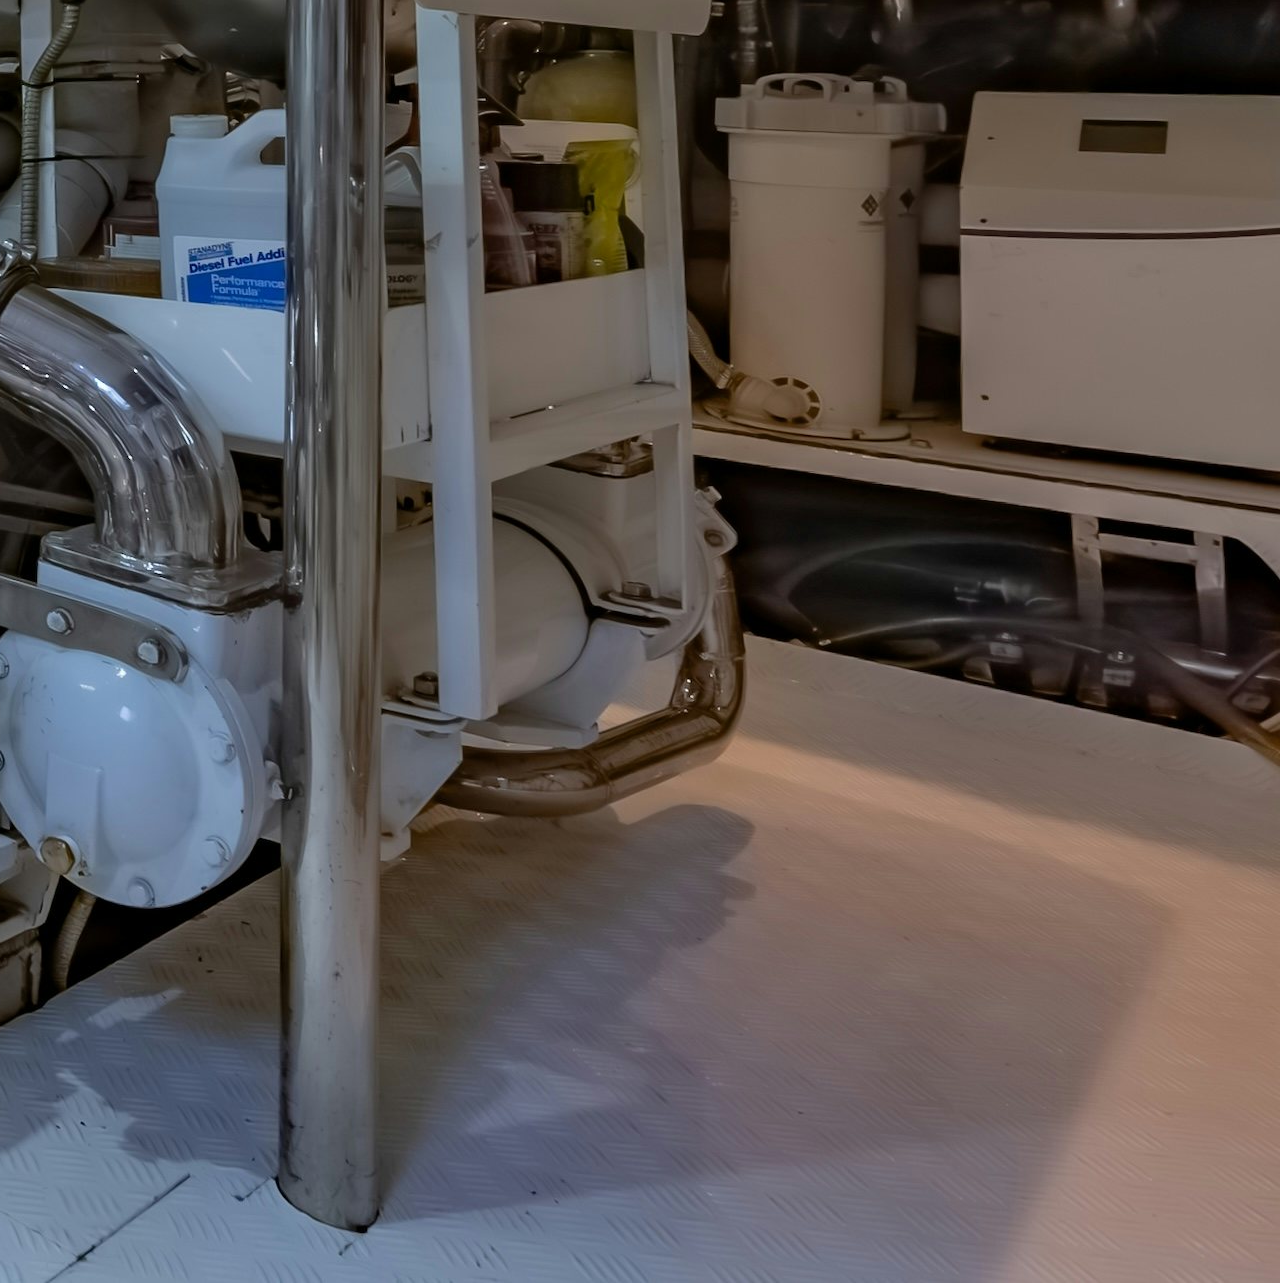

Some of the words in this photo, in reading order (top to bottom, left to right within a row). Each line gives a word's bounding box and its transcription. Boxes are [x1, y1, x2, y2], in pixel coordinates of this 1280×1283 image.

[188, 242, 233, 256] STANADYNE
[189, 258, 225, 274] Diesel
[228, 253, 253, 267] Fuel
[211, 273, 285, 289] Performance
[212, 283, 259, 296] Formula
